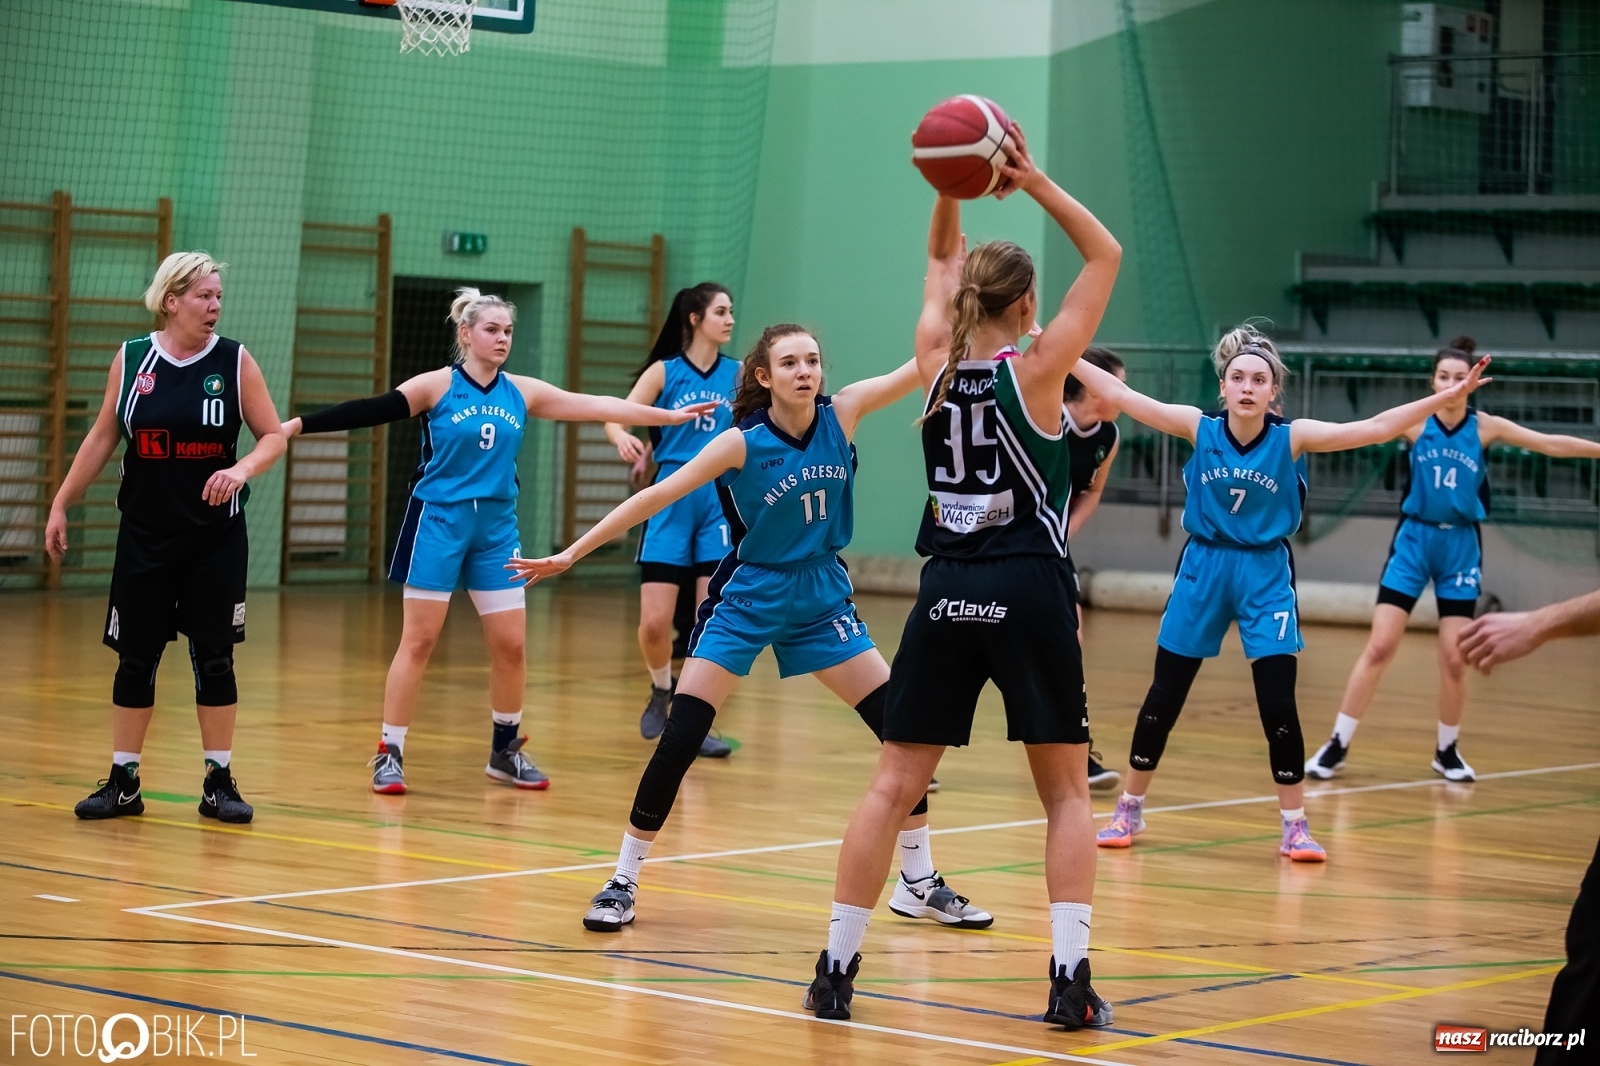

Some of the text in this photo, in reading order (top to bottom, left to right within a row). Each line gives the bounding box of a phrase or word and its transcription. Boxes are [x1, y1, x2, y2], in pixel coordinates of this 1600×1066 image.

[202, 398, 224, 427] 10
[451, 405, 478, 425] MLKS
[140, 433, 165, 455] K
[479, 423, 496, 450] 9
[935, 398, 1001, 485] 35
[763, 473, 798, 506] MLKS
[1200, 467, 1229, 485] MLKS
[1433, 465, 1457, 489] 14
[800, 489, 827, 525] 11
[1229, 488, 1246, 514] 7
[947, 600, 1008, 619] Clavis
[831, 615, 862, 643] 11
[1273, 611, 1289, 640] 7
